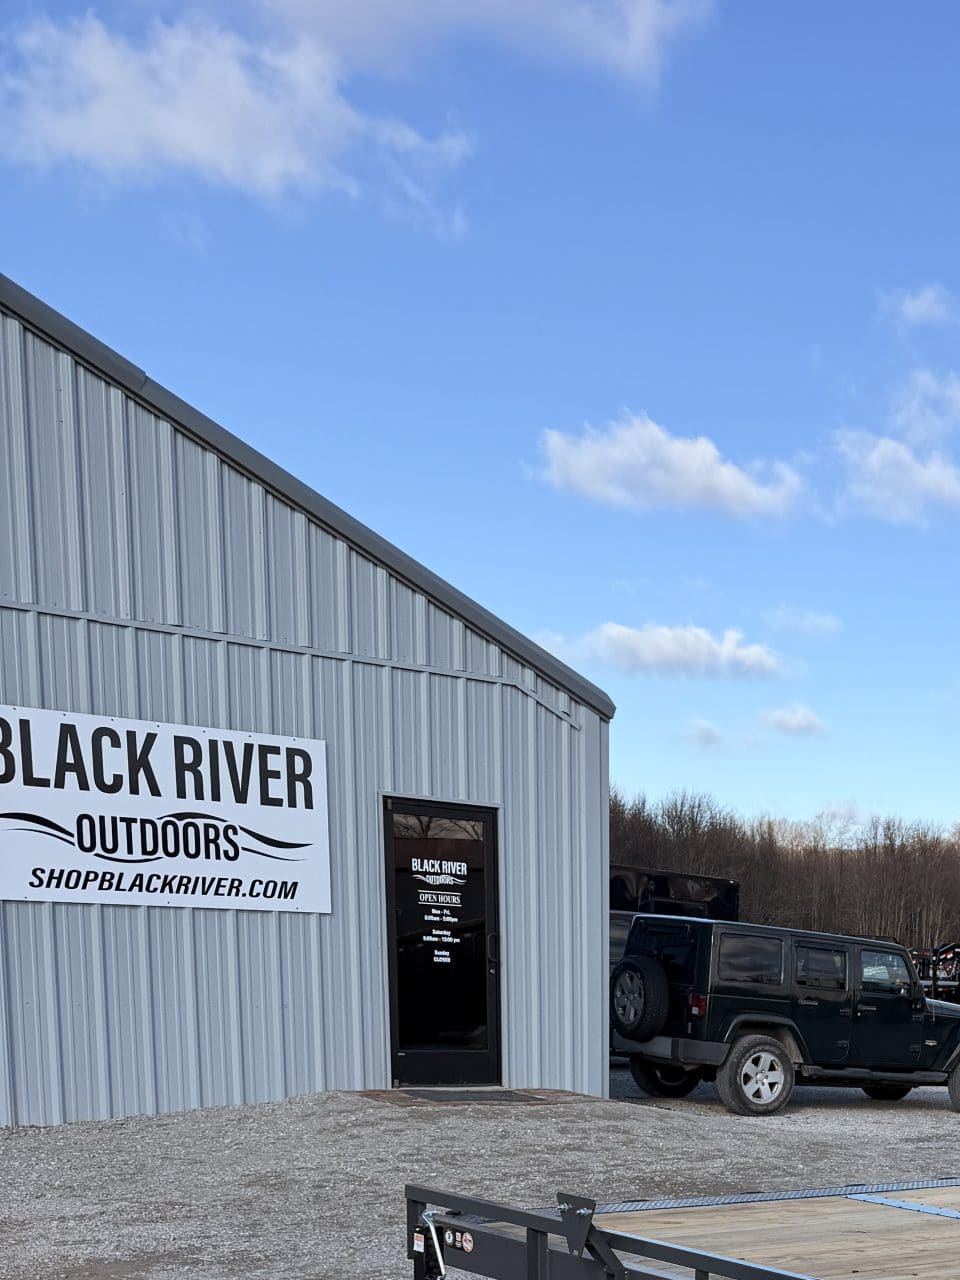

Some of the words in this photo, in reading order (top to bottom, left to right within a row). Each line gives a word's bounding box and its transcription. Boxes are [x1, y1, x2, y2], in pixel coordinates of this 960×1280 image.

[174, 735, 313, 809] RIVER
[76, 813, 240, 861] OUTDOORS
[29, 867, 298, 899] SHOPBLACKRIVER.COM
[411, 858, 441, 873] BLACK
[441, 860, 467, 876] RIVER
[419, 893, 437, 902] OPEN
[438, 895, 461, 904] HOURS
